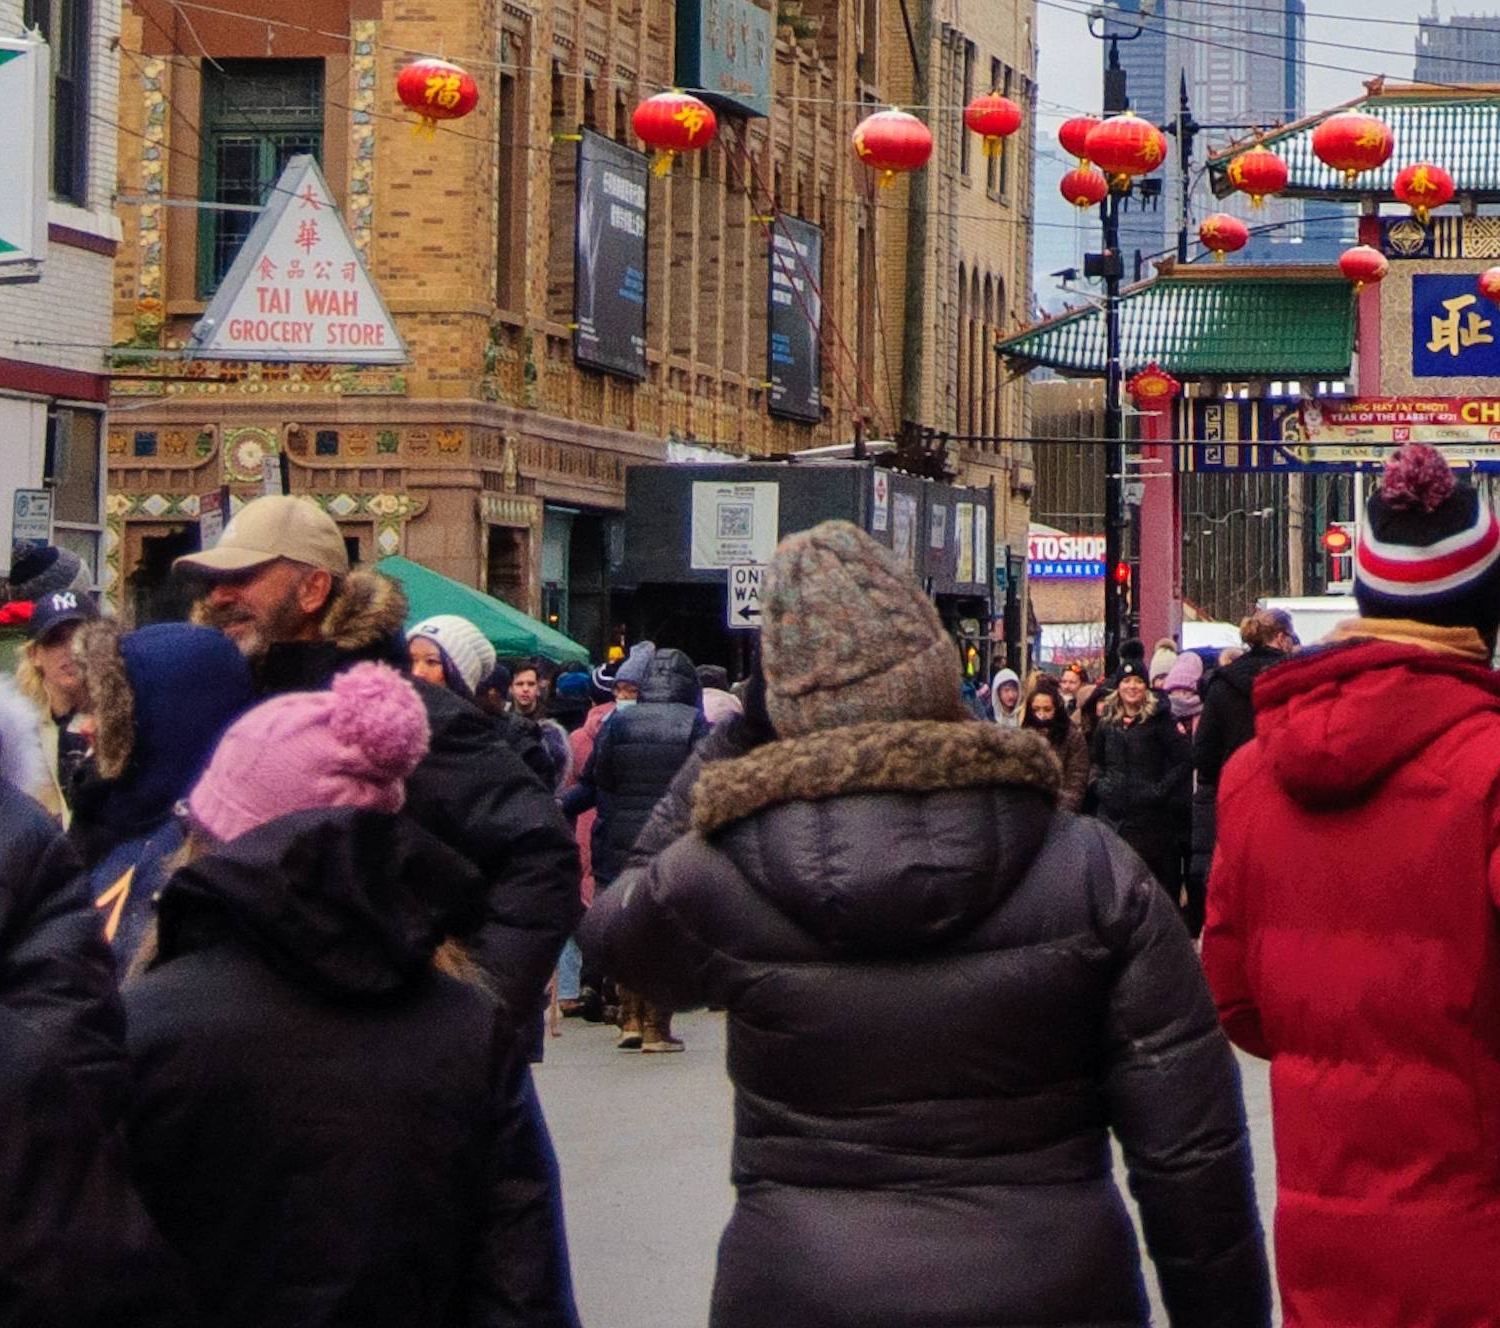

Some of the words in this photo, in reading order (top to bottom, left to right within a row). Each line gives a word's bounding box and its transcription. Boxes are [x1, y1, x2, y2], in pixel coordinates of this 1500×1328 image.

[256, 287, 290, 314] TAI
[304, 289, 358, 317] WAH
[228, 319, 314, 343] GROCERY
[326, 322, 385, 346] STORE
[736, 569, 763, 584] ON
[735, 587, 760, 601] WA
